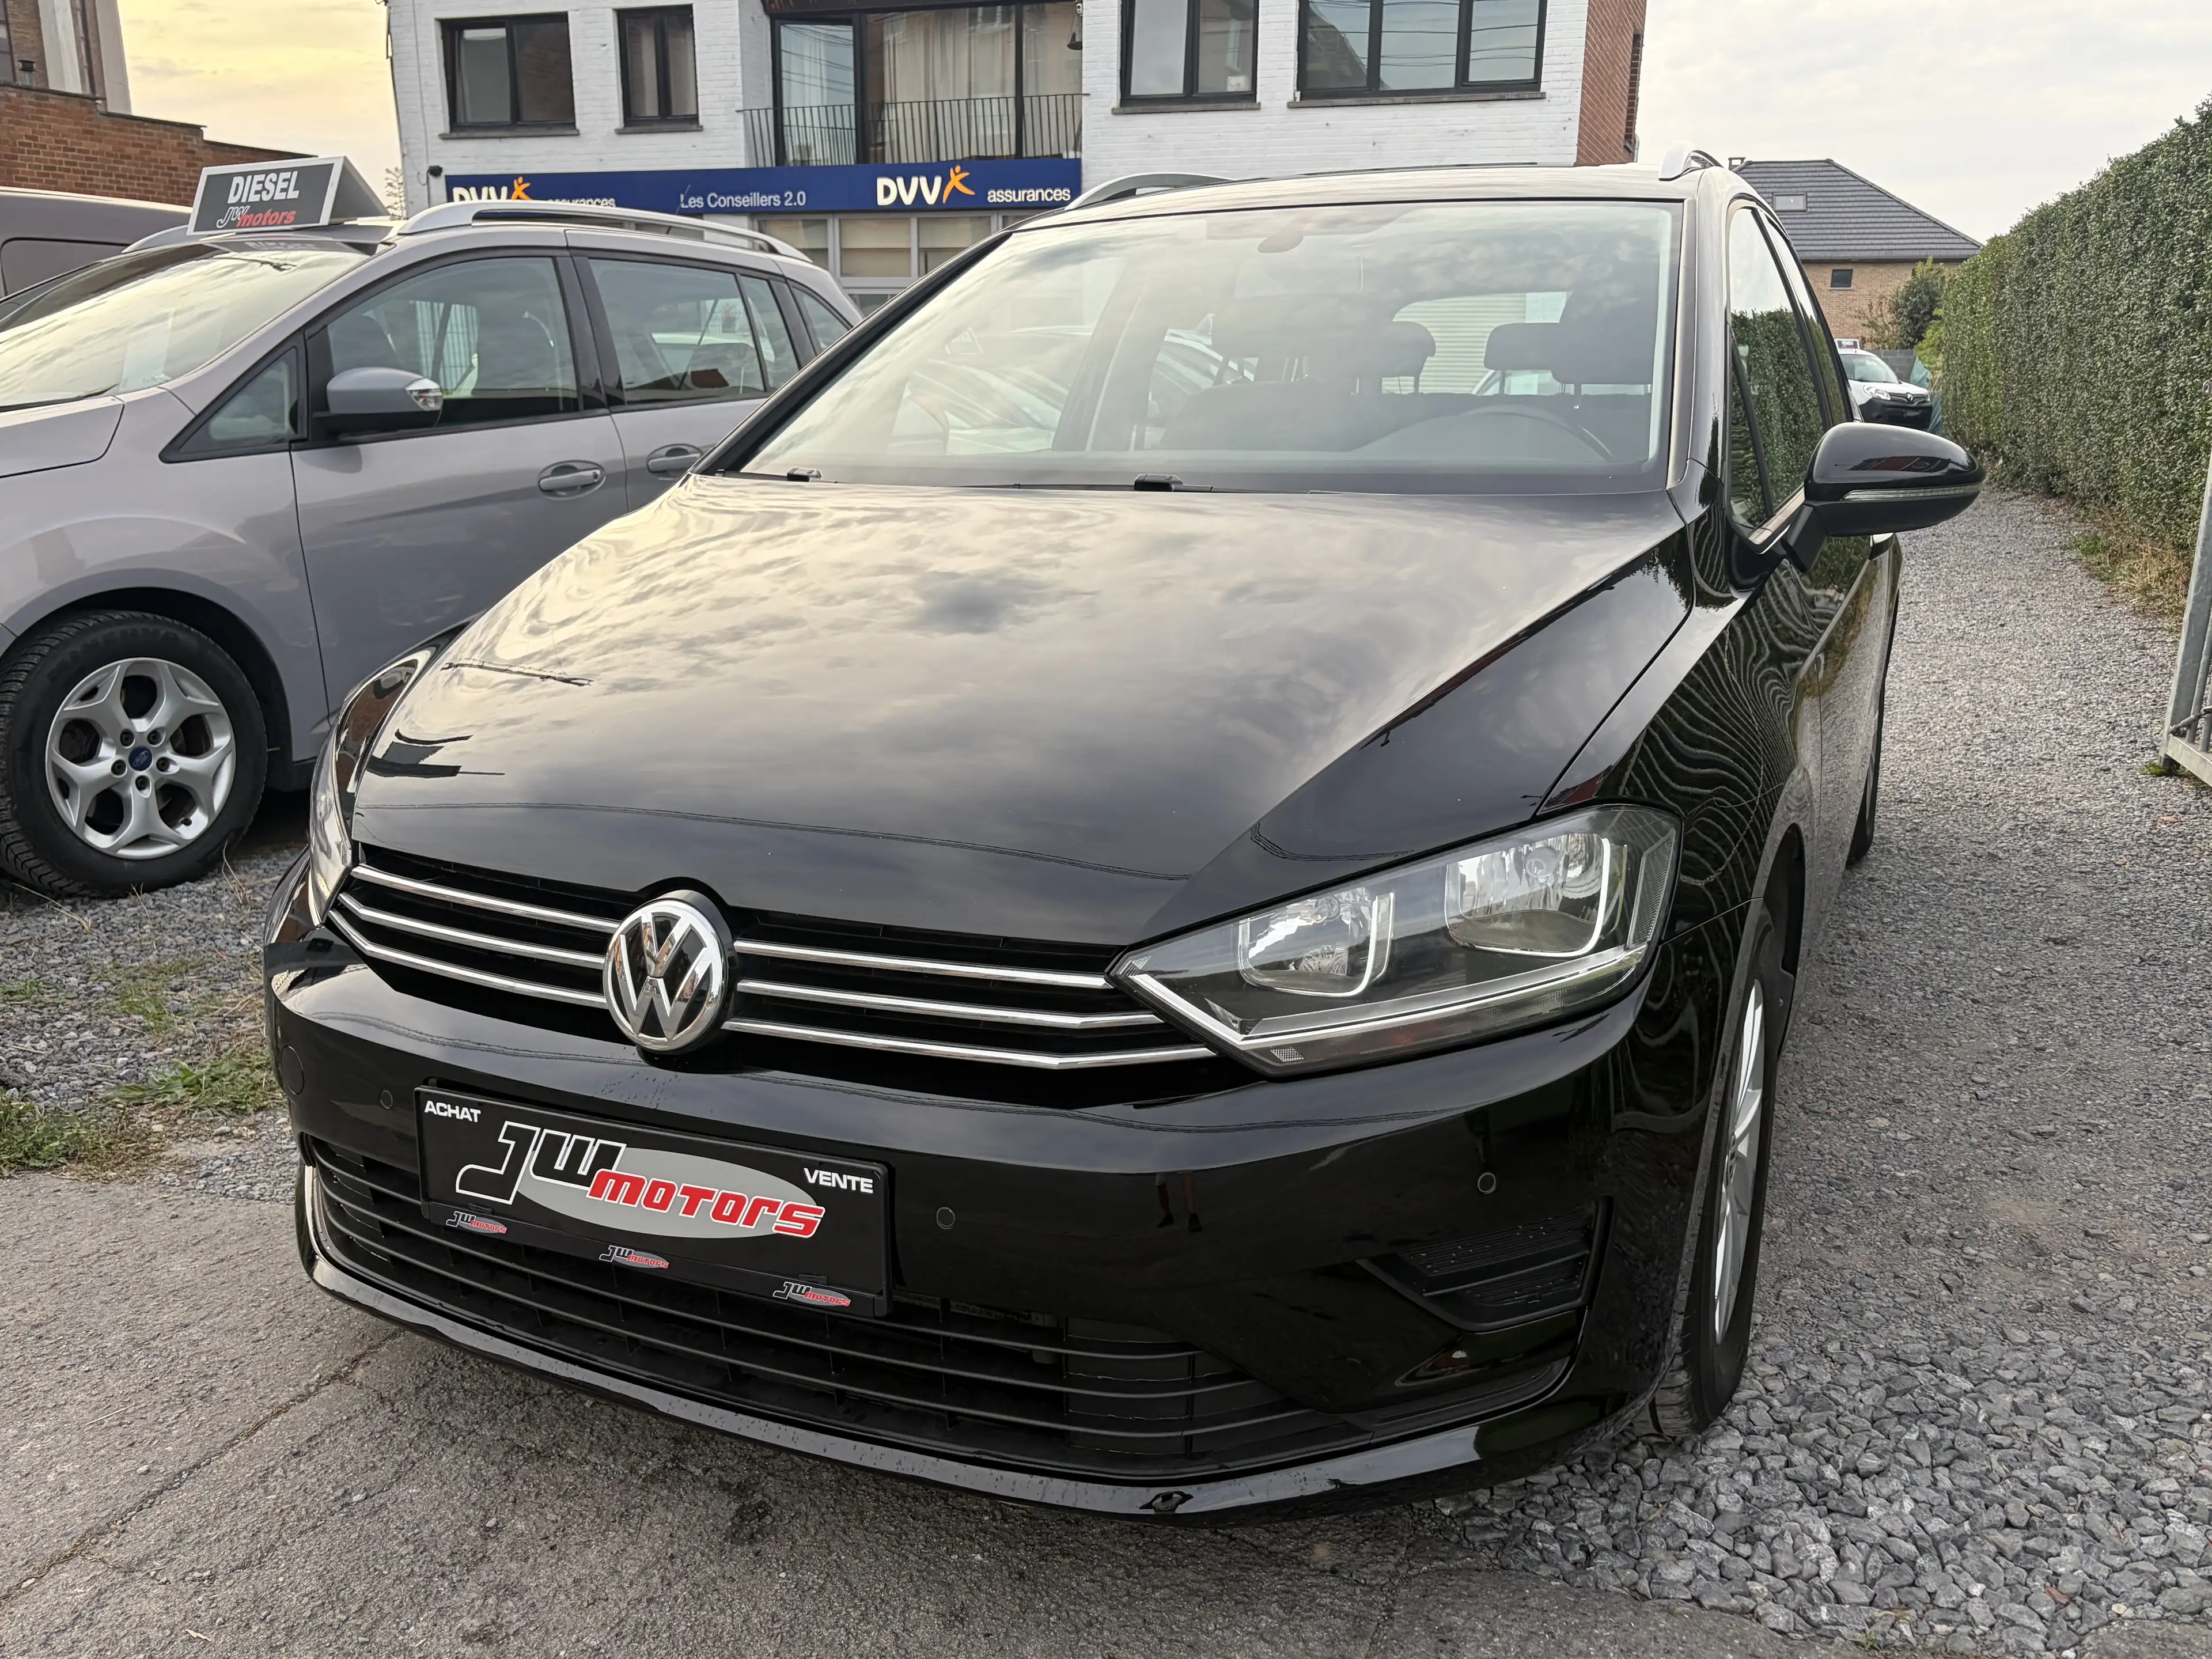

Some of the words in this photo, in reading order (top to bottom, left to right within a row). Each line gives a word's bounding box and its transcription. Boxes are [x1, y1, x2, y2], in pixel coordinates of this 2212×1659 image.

[227, 170, 300, 204] DIESEL
[680, 193, 704, 209] Les
[707, 190, 781, 208] Conseillers
[784, 190, 806, 206] 2.0
[876, 175, 942, 206] DVV
[987, 186, 1071, 203] assurances
[216, 205, 250, 229] JW
[236, 209, 296, 228] motors
[424, 1100, 481, 1123] ACHAT
[456, 1120, 627, 1205] JW
[803, 1168, 874, 1194] VENTE
